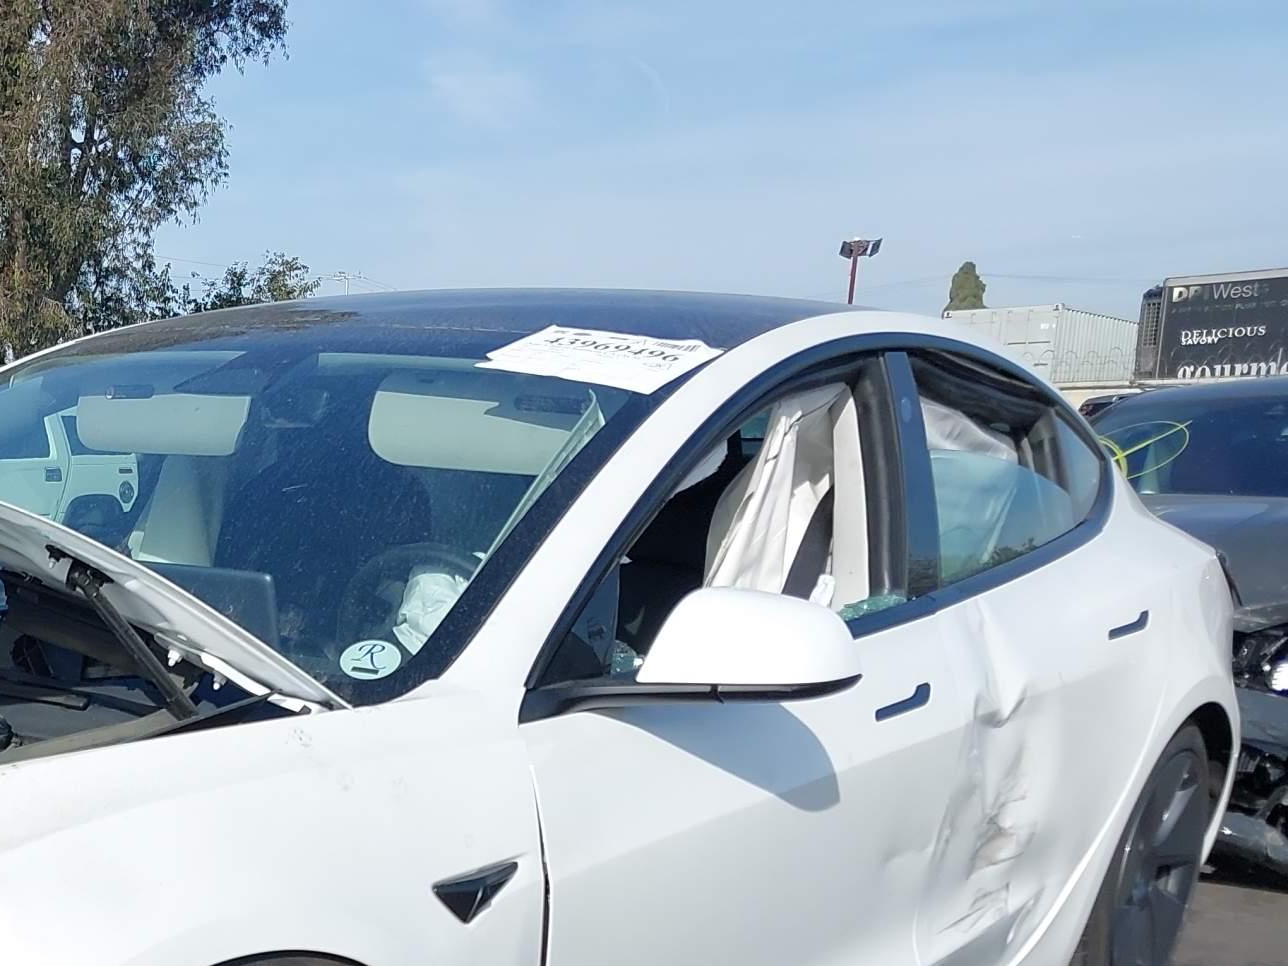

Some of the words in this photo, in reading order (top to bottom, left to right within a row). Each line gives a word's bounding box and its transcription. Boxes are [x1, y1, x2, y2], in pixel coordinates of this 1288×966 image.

[1213, 282, 1259, 299] West
[1181, 325, 1267, 341] DELICIOUS
[1181, 336, 1220, 346] SAVORY
[544, 336, 680, 362] 43969496
